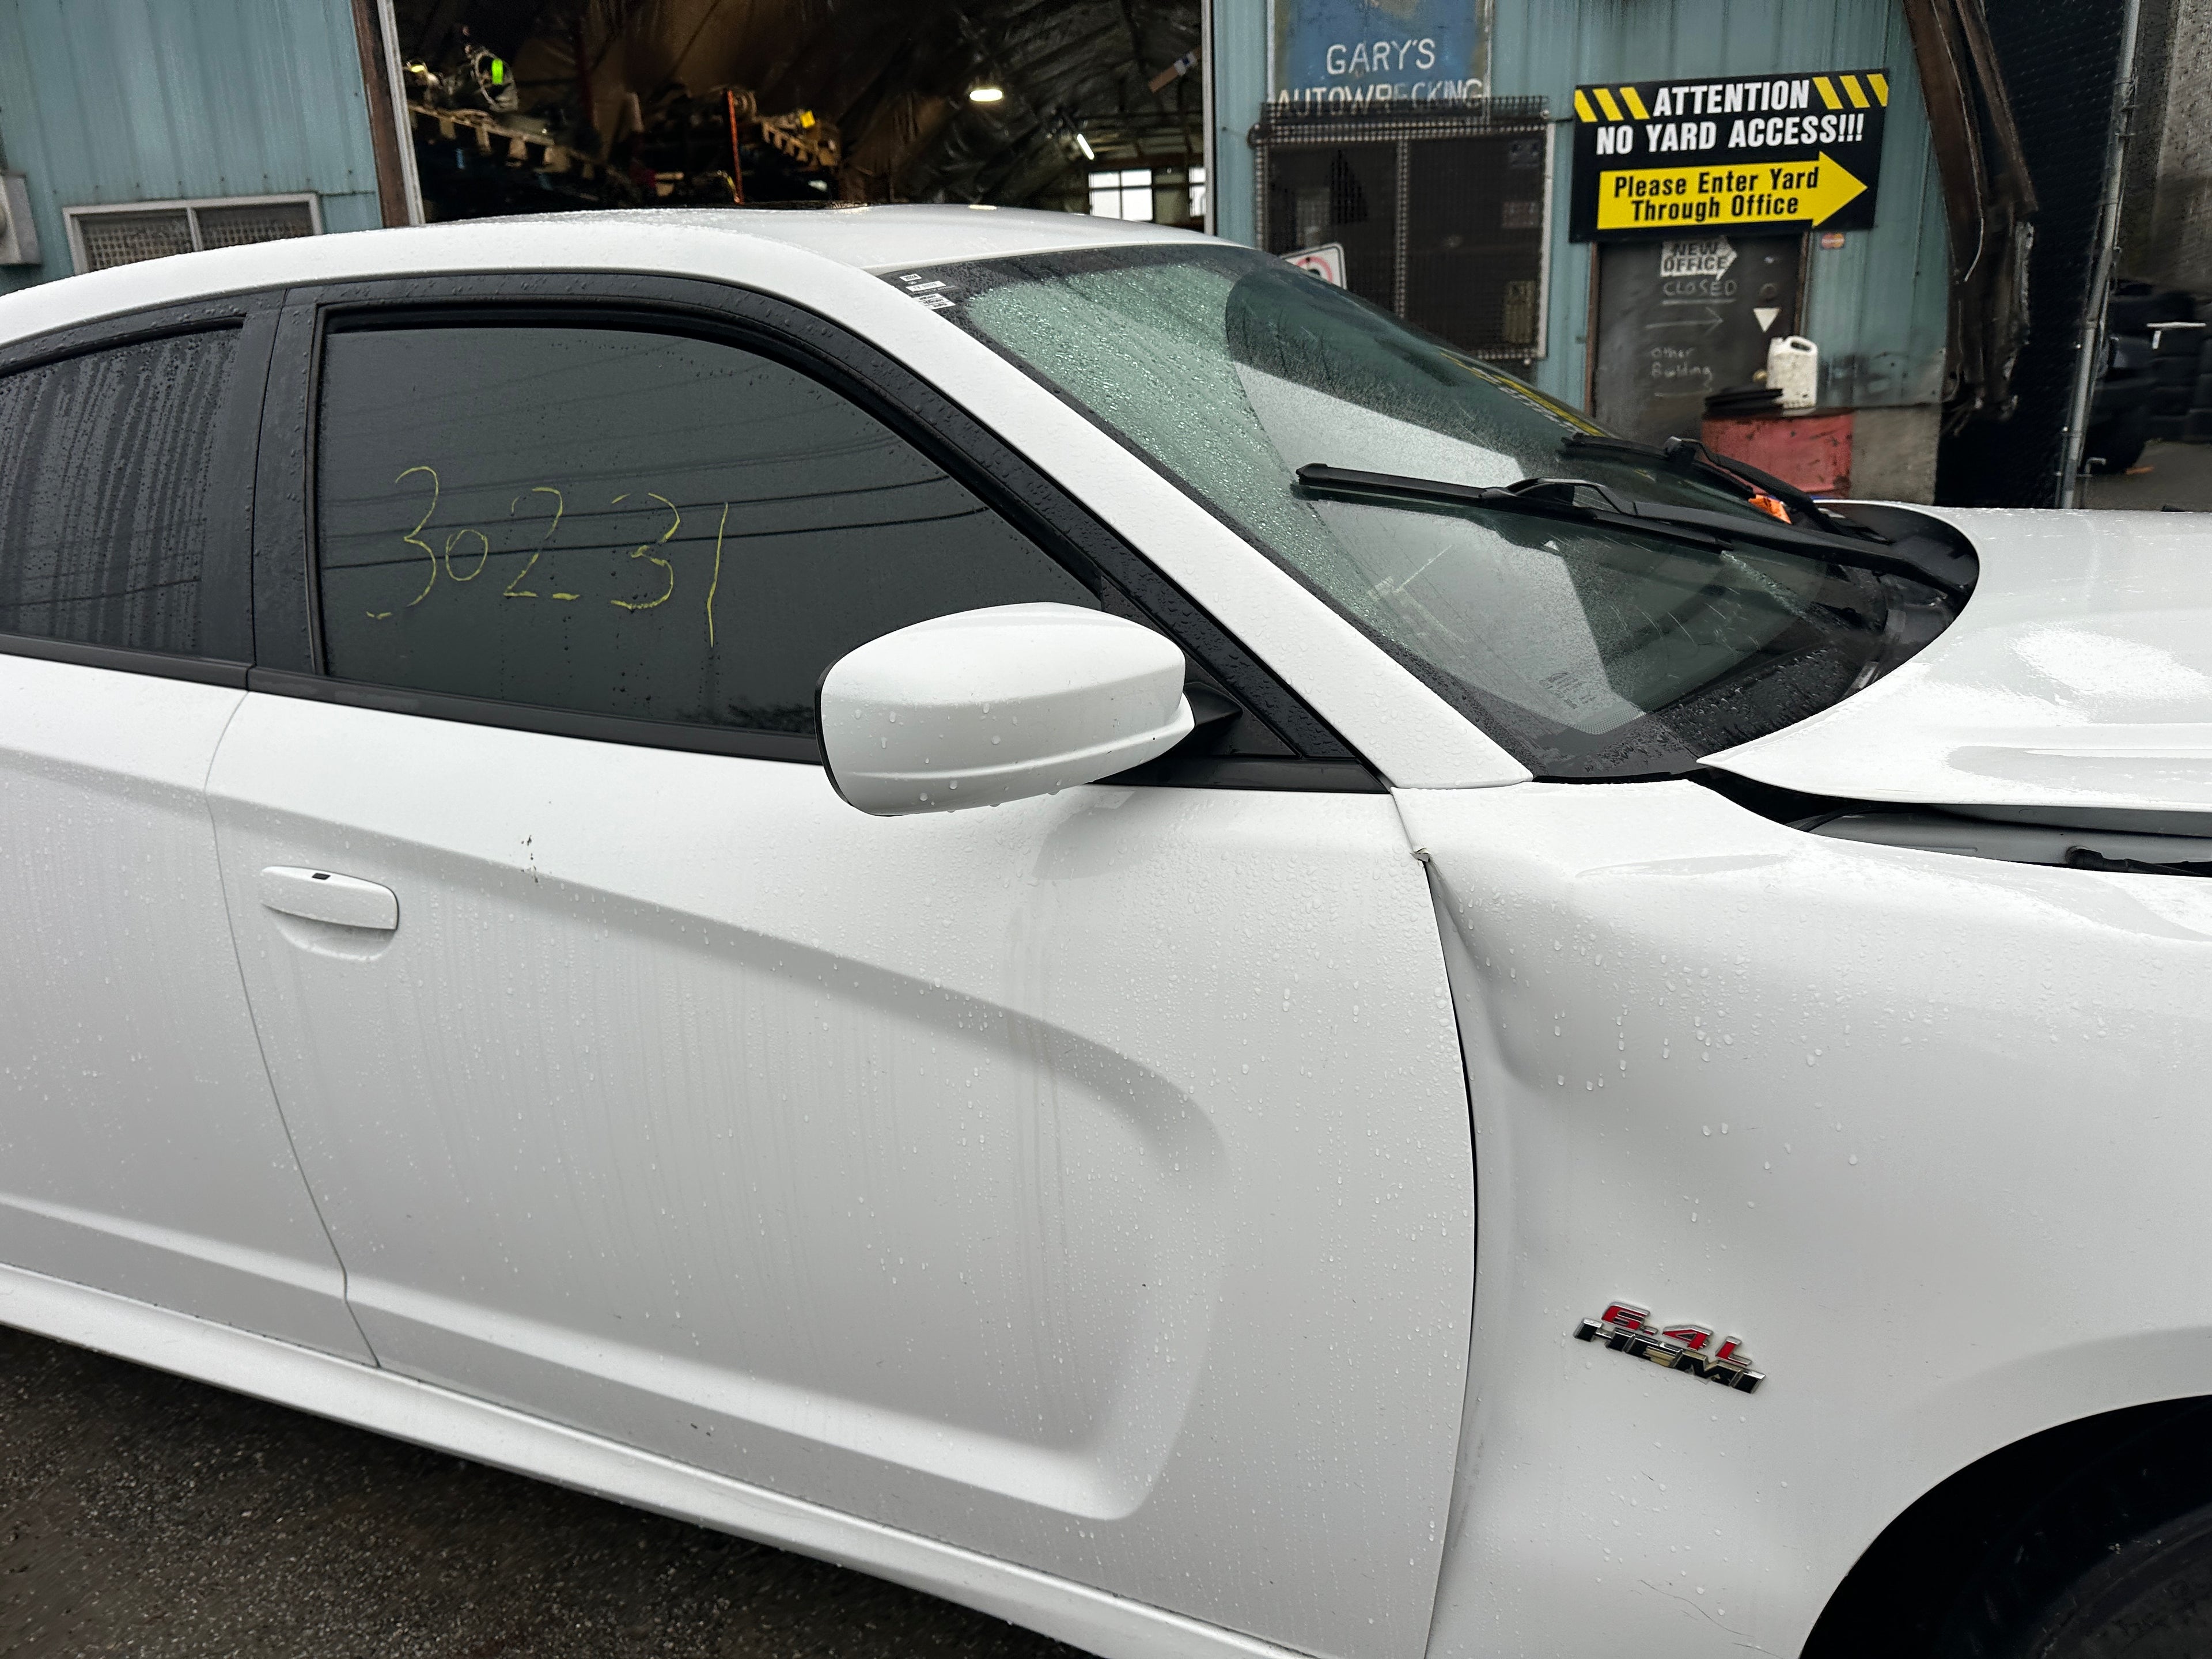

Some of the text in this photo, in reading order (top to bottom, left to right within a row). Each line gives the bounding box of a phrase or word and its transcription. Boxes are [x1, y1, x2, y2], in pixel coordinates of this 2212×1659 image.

[1326, 37, 1435, 75] GARY'S
[1652, 79, 1810, 116] ATTENTION
[1596, 113, 1864, 156] NO YARD ACCESS!!!
[1614, 166, 1820, 198] Please Enter Yard
[1631, 194, 1799, 223] Through Office
[1663, 256, 1728, 272] OFFICE
[1670, 241, 1718, 256] NEW
[1663, 279, 1737, 297] CLOSED
[1601, 1301, 1752, 1368] 6.4L
[1573, 1317, 1766, 1394] HEMI
